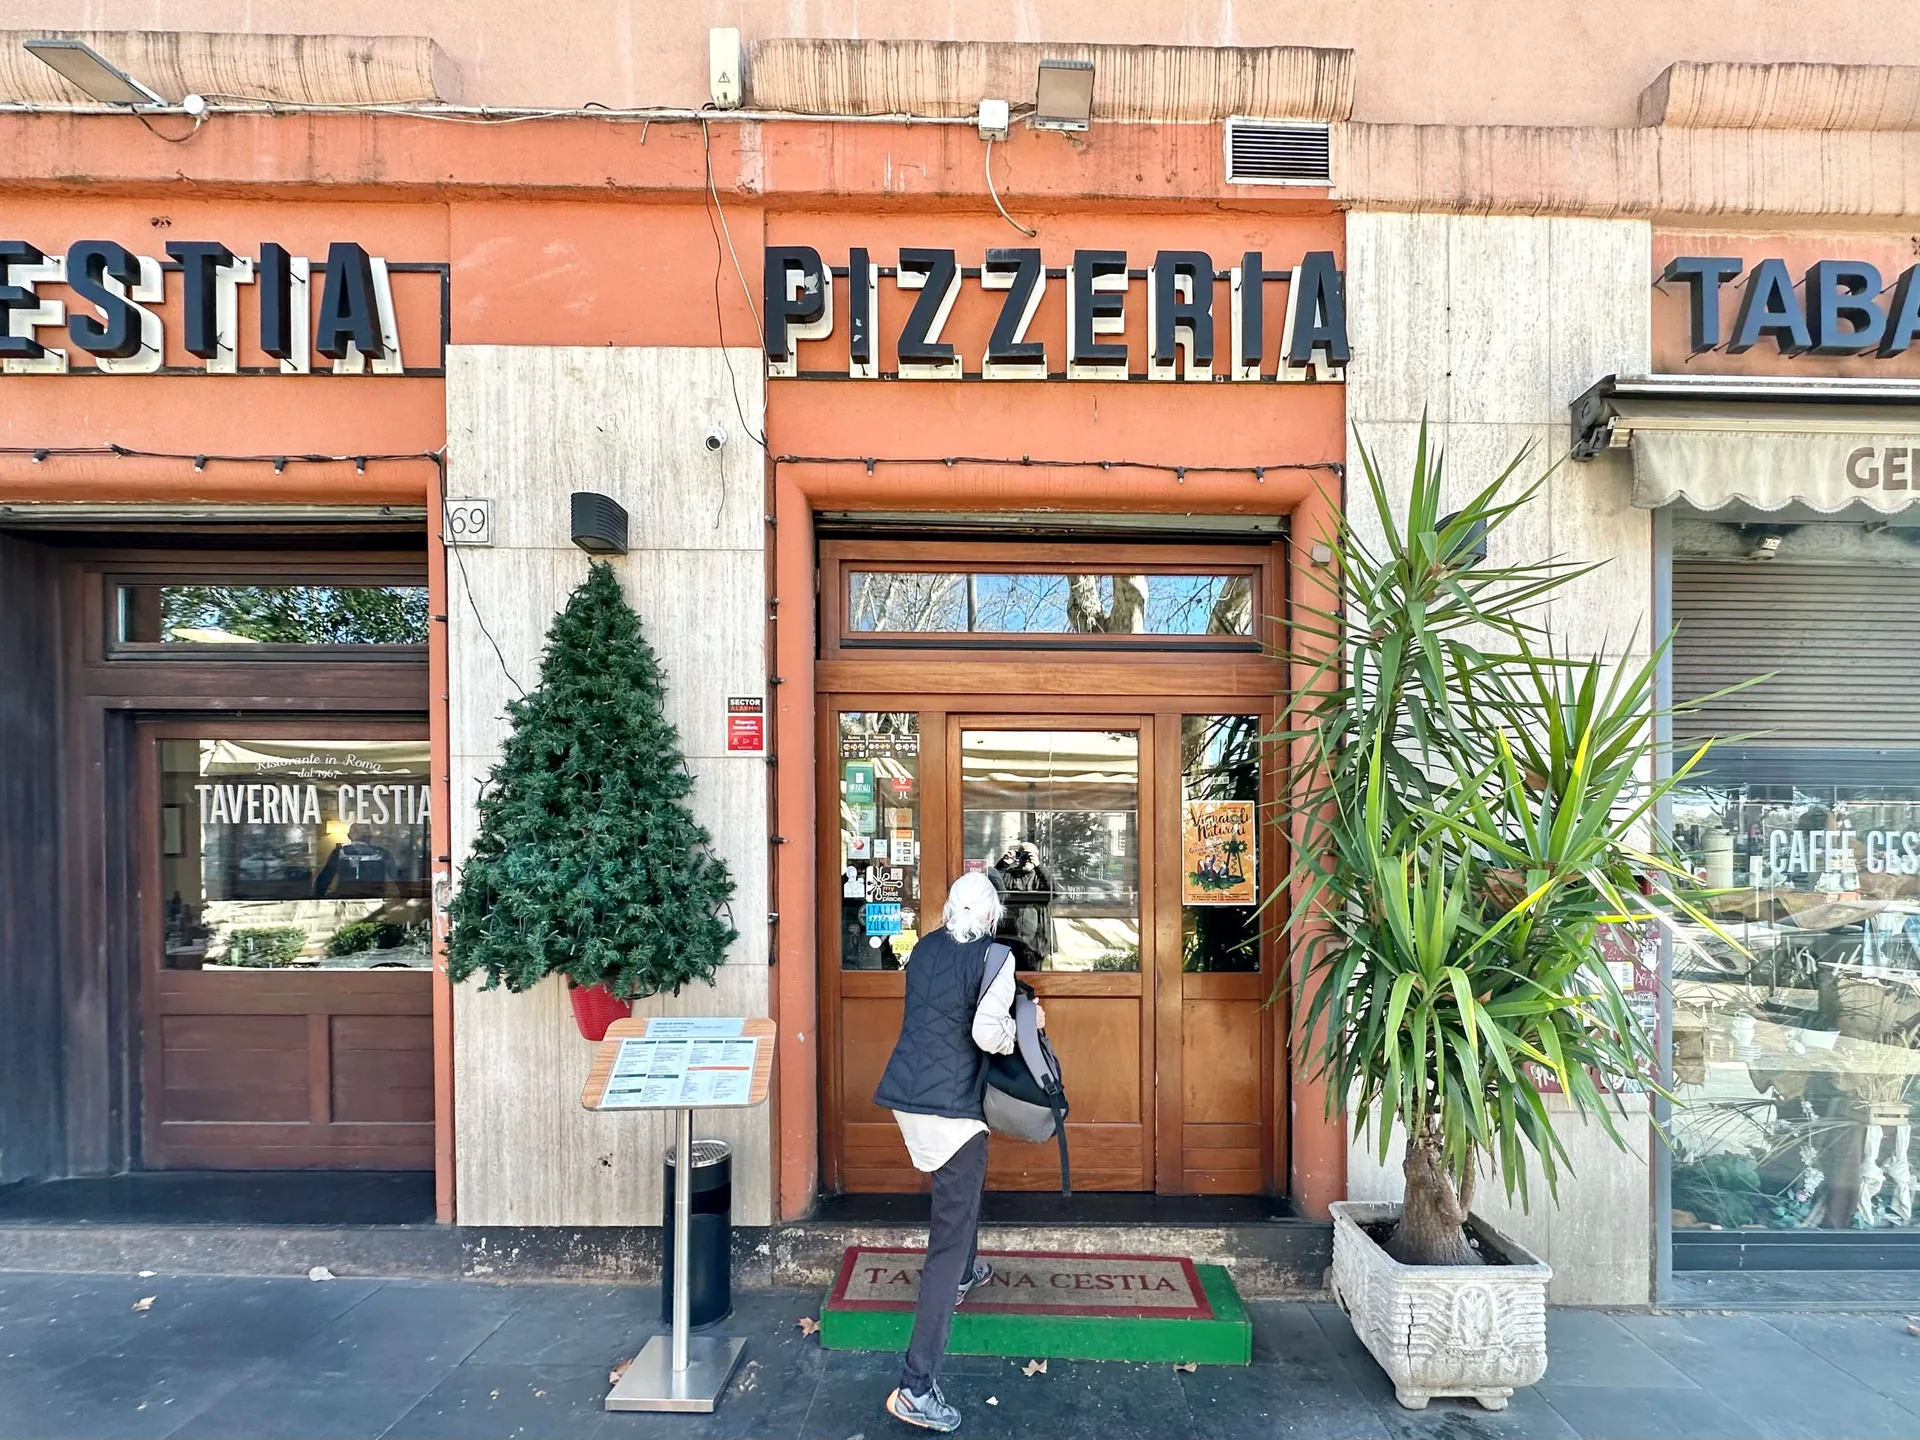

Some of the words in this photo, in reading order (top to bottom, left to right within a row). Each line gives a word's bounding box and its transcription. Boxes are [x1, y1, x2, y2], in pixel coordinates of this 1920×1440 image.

[764, 246, 1351, 372] PIZZERIA
[1846, 447, 1920, 490] GE
[450, 507, 485, 534] 69
[255, 752, 321, 771] Ristorante
[325, 753, 337, 765] in
[343, 753, 383, 771] Roma
[298, 768, 314, 778] dal
[195, 784, 322, 825] TAVERNA
[337, 784, 432, 825] CESTIA
[1866, 830, 1920, 874] CES
[868, 905, 899, 915] ITALIA
[864, 1267, 1038, 1289] TANA
[1050, 1272, 1180, 1292] CESTIA
